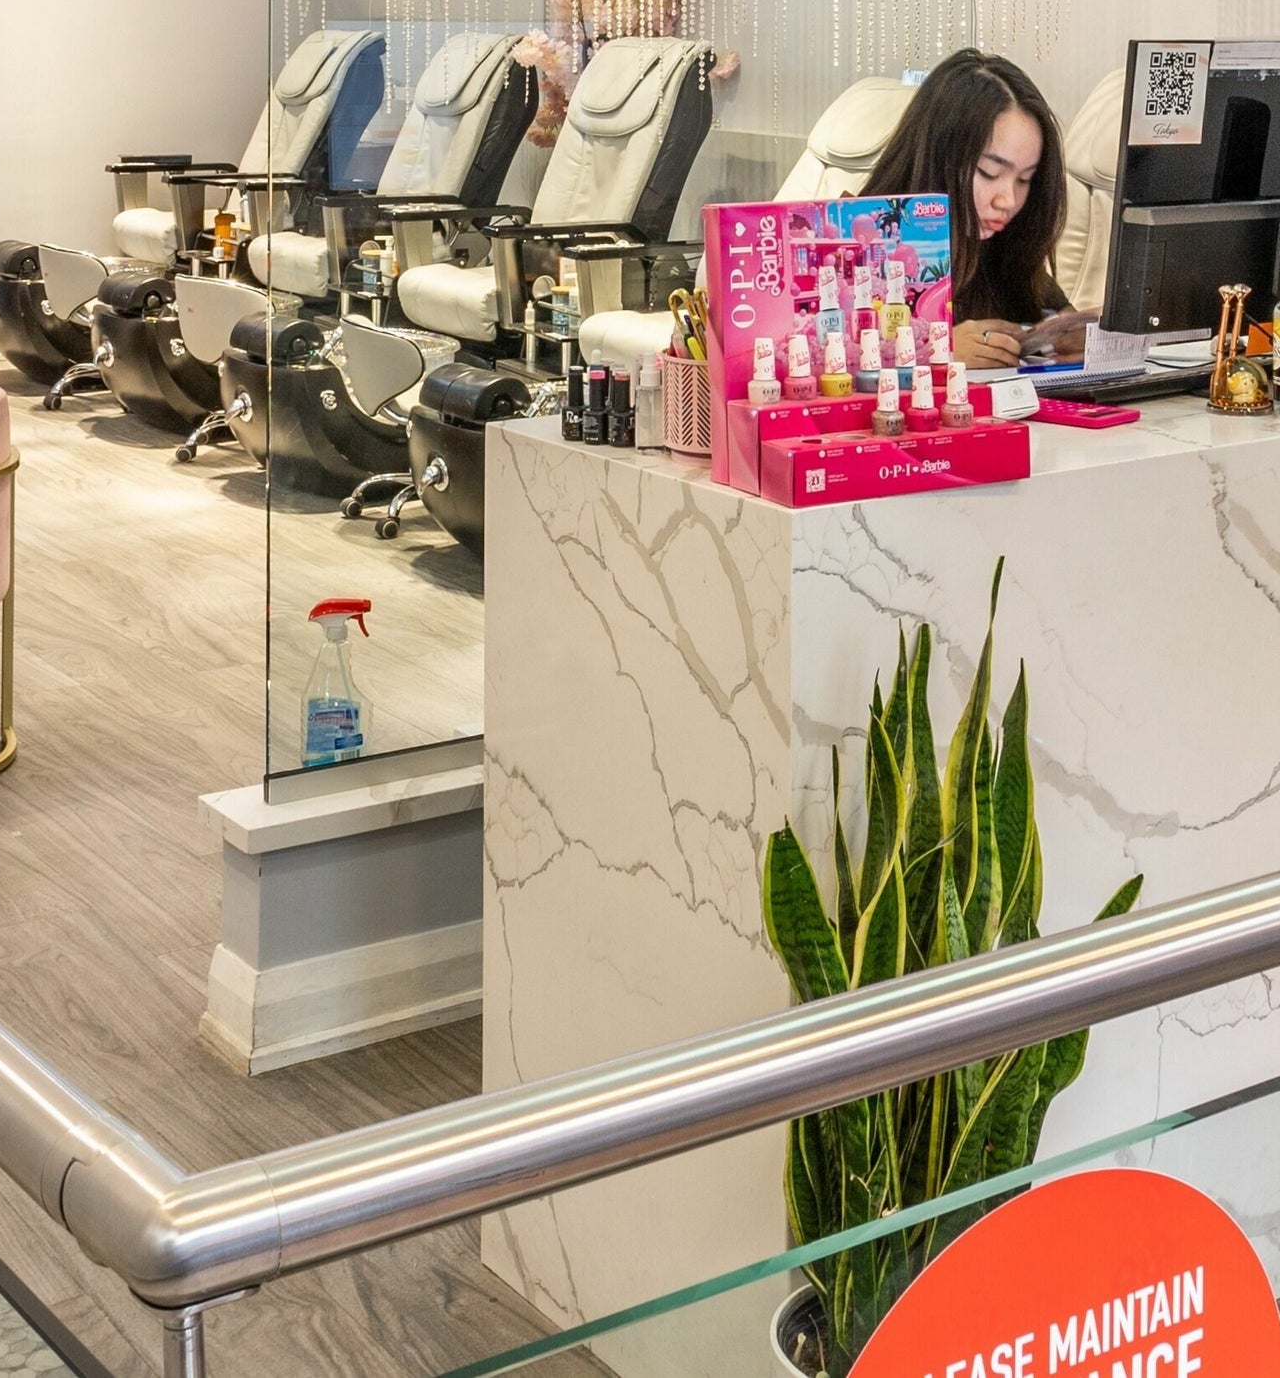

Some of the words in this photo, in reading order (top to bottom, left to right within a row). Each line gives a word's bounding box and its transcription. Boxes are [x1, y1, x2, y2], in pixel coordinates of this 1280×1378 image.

[755, 215, 781, 296] Barbie
[920, 459, 951, 474] Barbie
[1049, 1265, 1204, 1375] MAINTAIN
